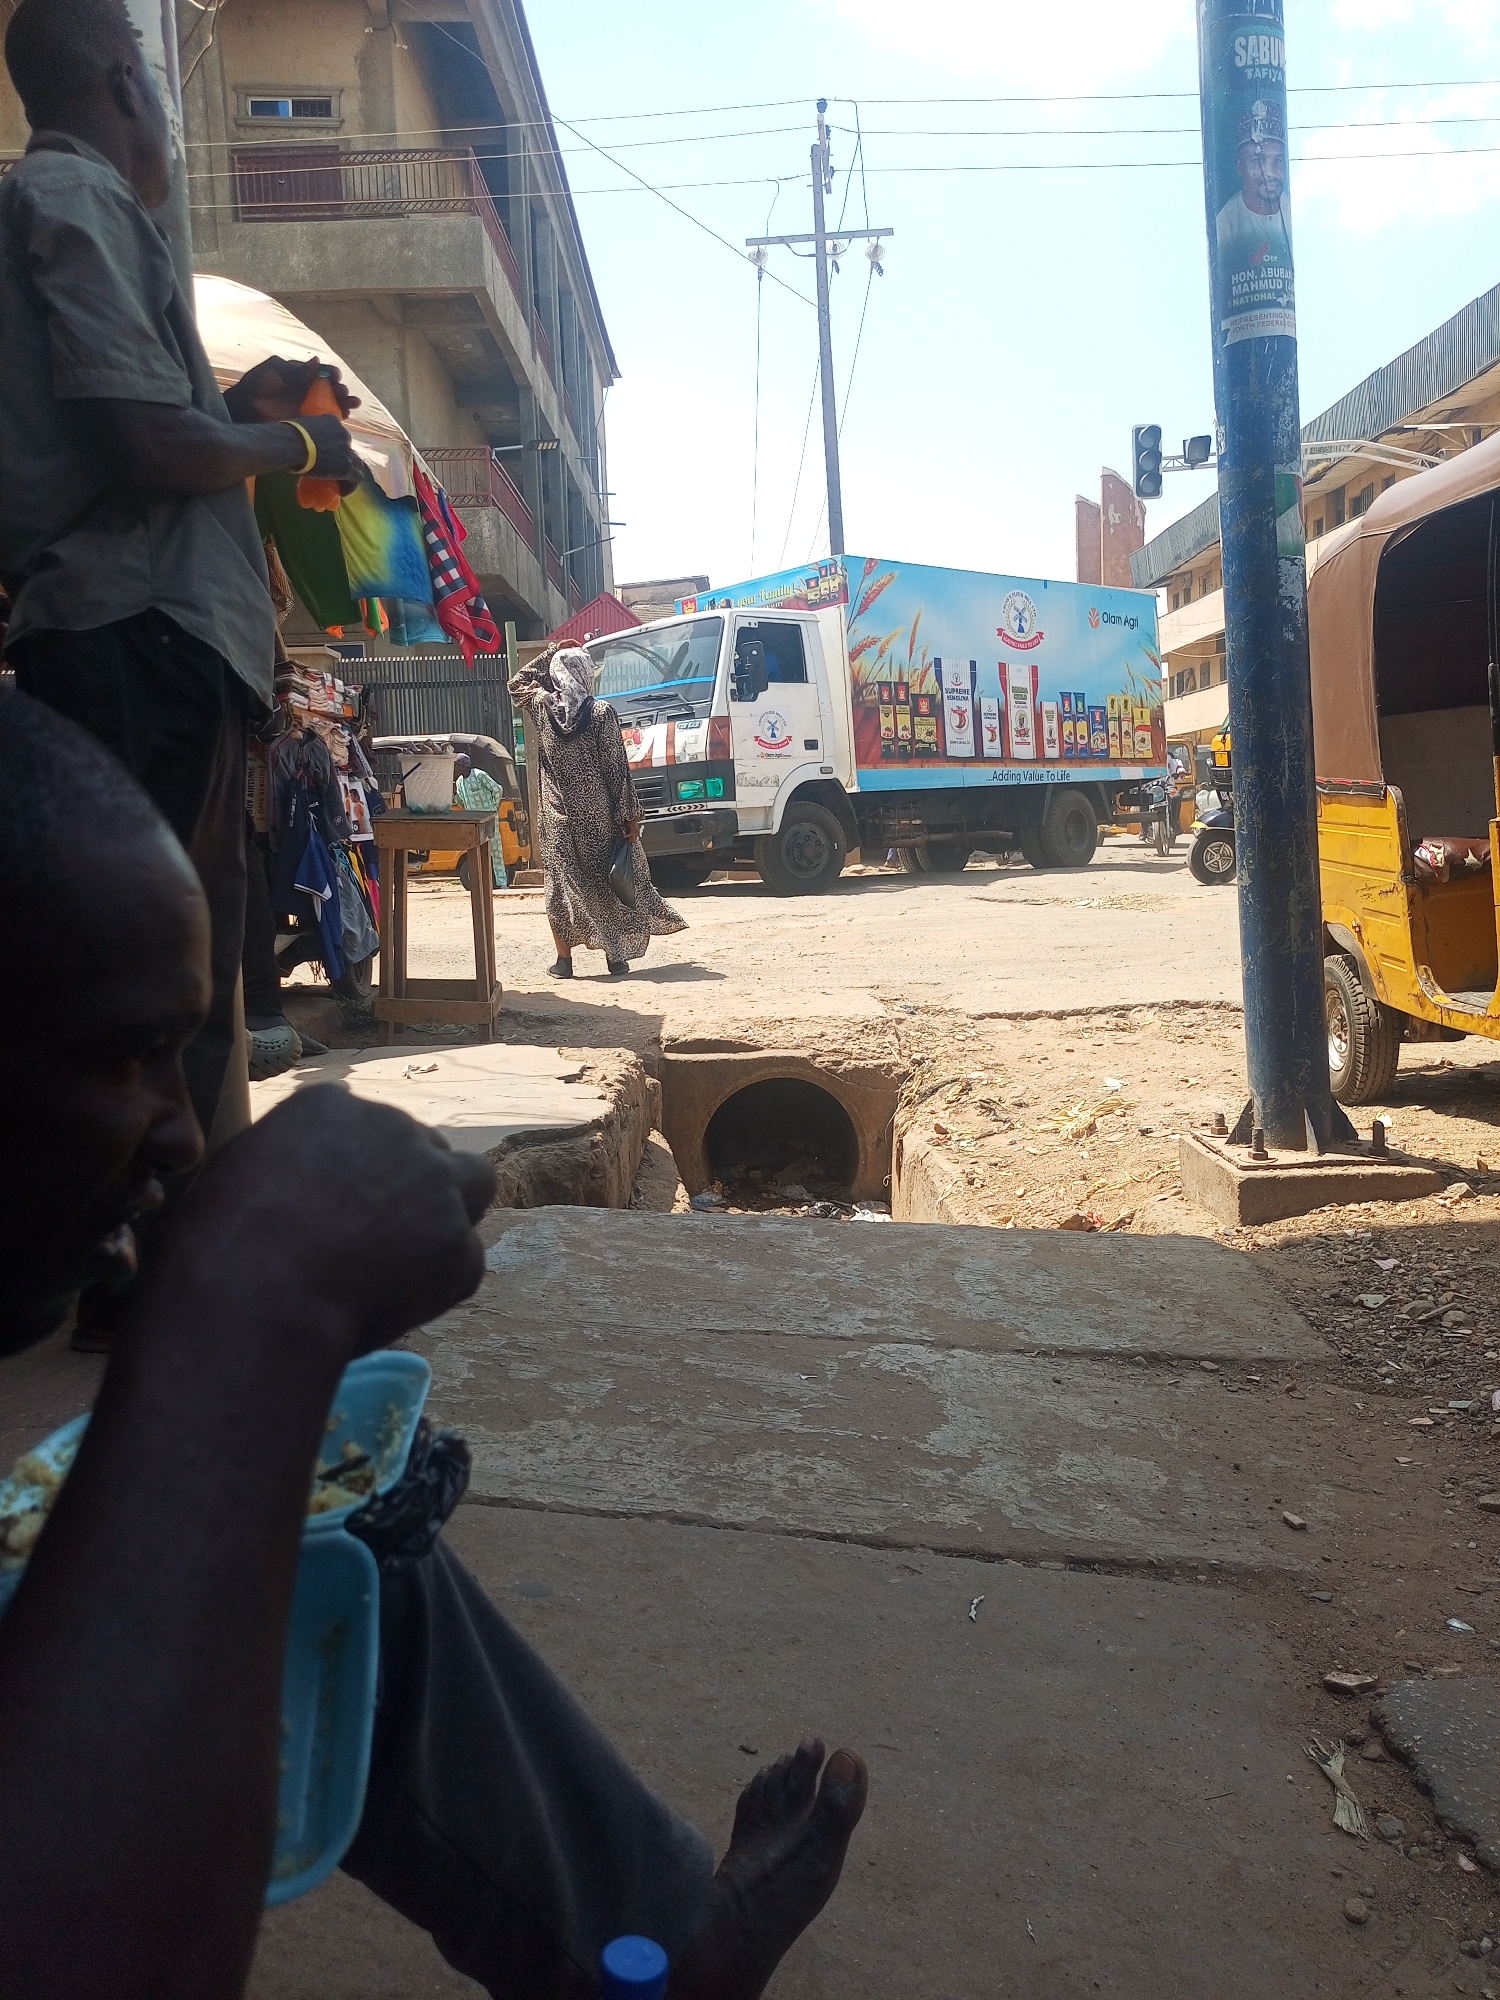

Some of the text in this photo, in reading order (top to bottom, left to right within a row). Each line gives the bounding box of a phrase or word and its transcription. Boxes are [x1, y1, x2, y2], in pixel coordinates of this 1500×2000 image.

[1244, 67, 1284, 82] TAFIYA
[1231, 269, 1258, 285] HON.
[1232, 278, 1283, 297] MAHMUD
[1232, 292, 1277, 307] NATIONAL
[1102, 611, 1139, 630] Olam Agri
[1022, 769, 1044, 782] Value
[1045, 770, 1056, 782] To
[1056, 769, 1071, 781] Life
